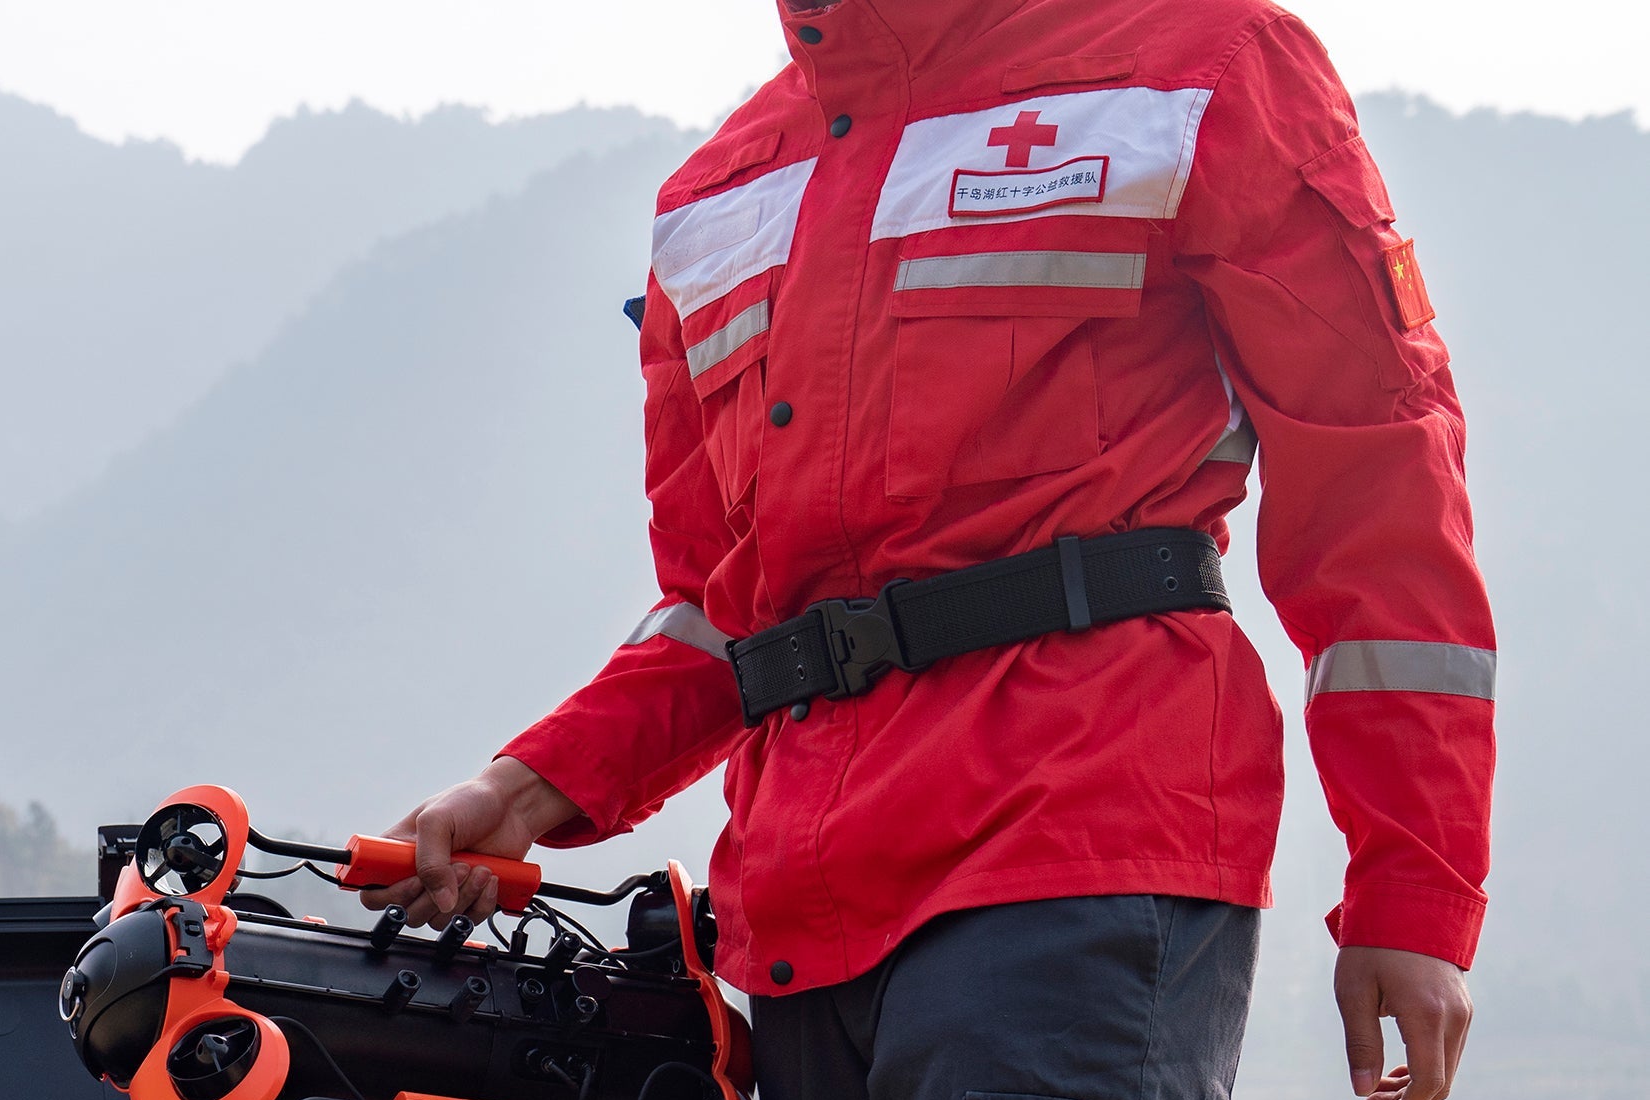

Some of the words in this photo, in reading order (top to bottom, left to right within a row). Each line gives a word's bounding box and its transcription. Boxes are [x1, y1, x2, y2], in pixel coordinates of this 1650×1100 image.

[957, 171, 1097, 200] 千岛湖红十字公益救援队
